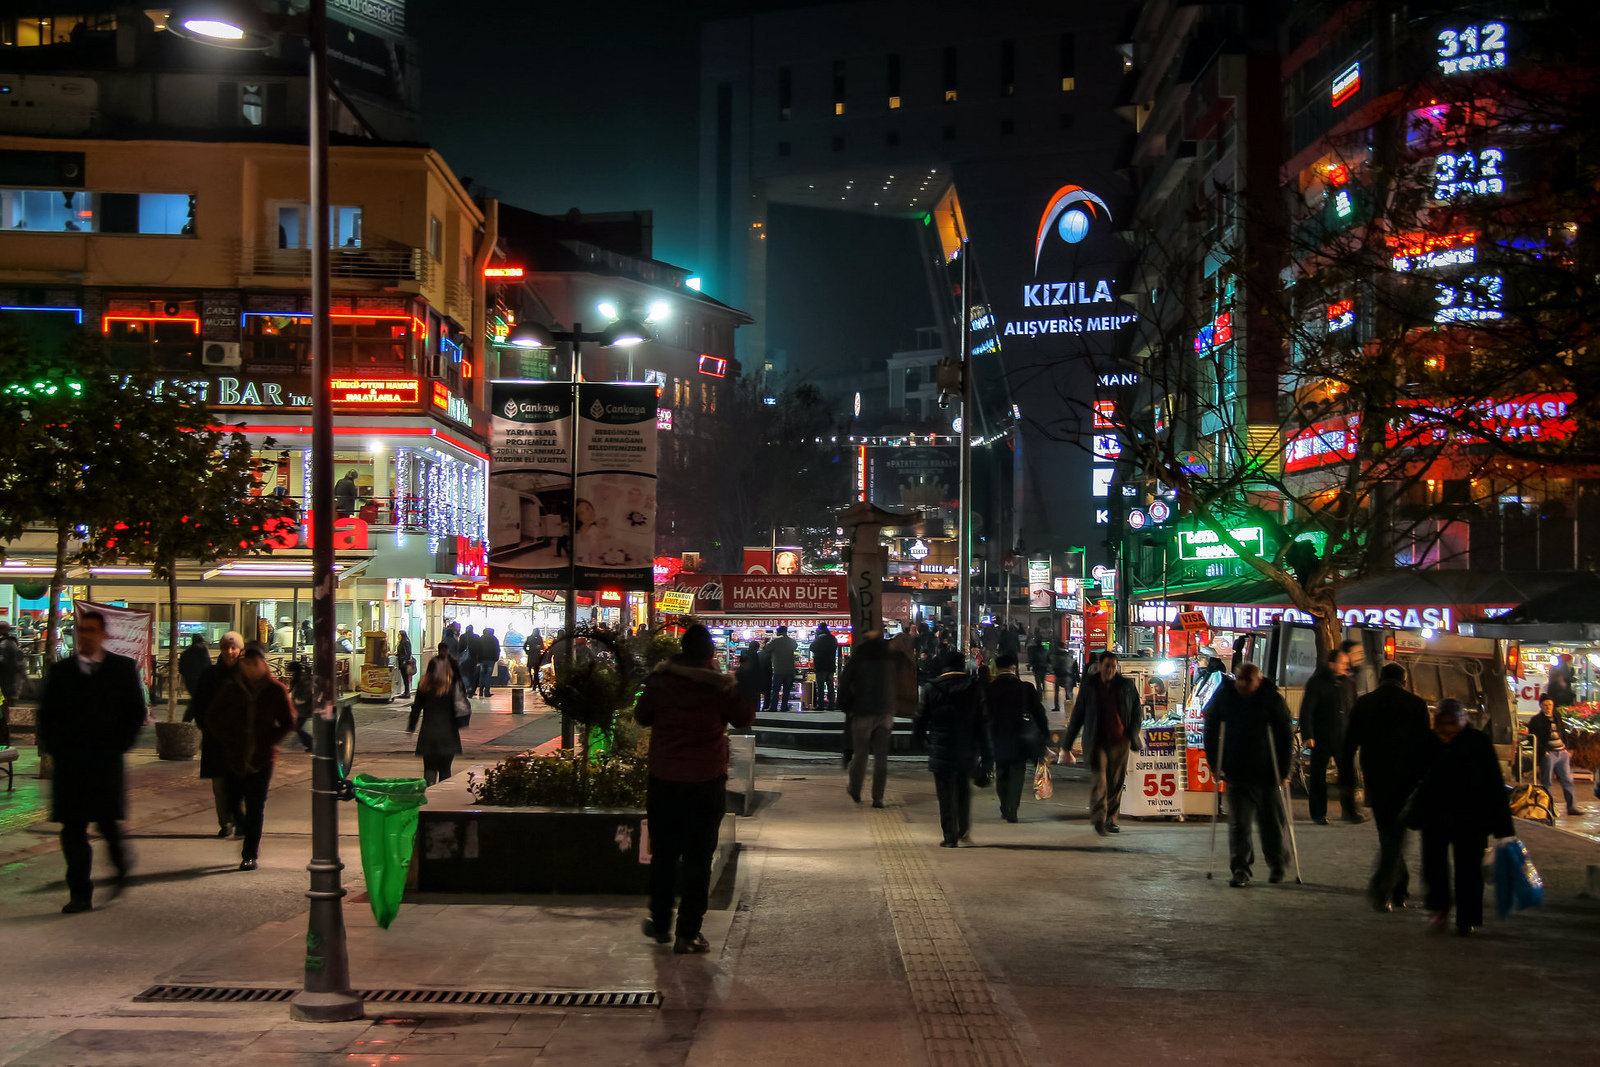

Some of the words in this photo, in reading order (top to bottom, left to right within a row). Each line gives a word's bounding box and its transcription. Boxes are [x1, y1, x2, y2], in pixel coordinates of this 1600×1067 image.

[1437, 22, 1506, 57] 312
[1023, 279, 1116, 307] KIZILA
[1004, 315, 1082, 338] ALIŞVERİŞ
[219, 377, 284, 406] BAR
[519, 402, 560, 414] Çankaya
[505, 428, 532, 437] YARIM
[534, 429, 557, 437] ELMA
[733, 586, 790, 600] HAKAN
[795, 583, 838, 600] BÜFE
[788, 619, 807, 627] FAKS
[1181, 613, 1205, 623] VISA
[1337, 607, 1451, 631] ORSASI
[1142, 773, 1176, 797] 55
